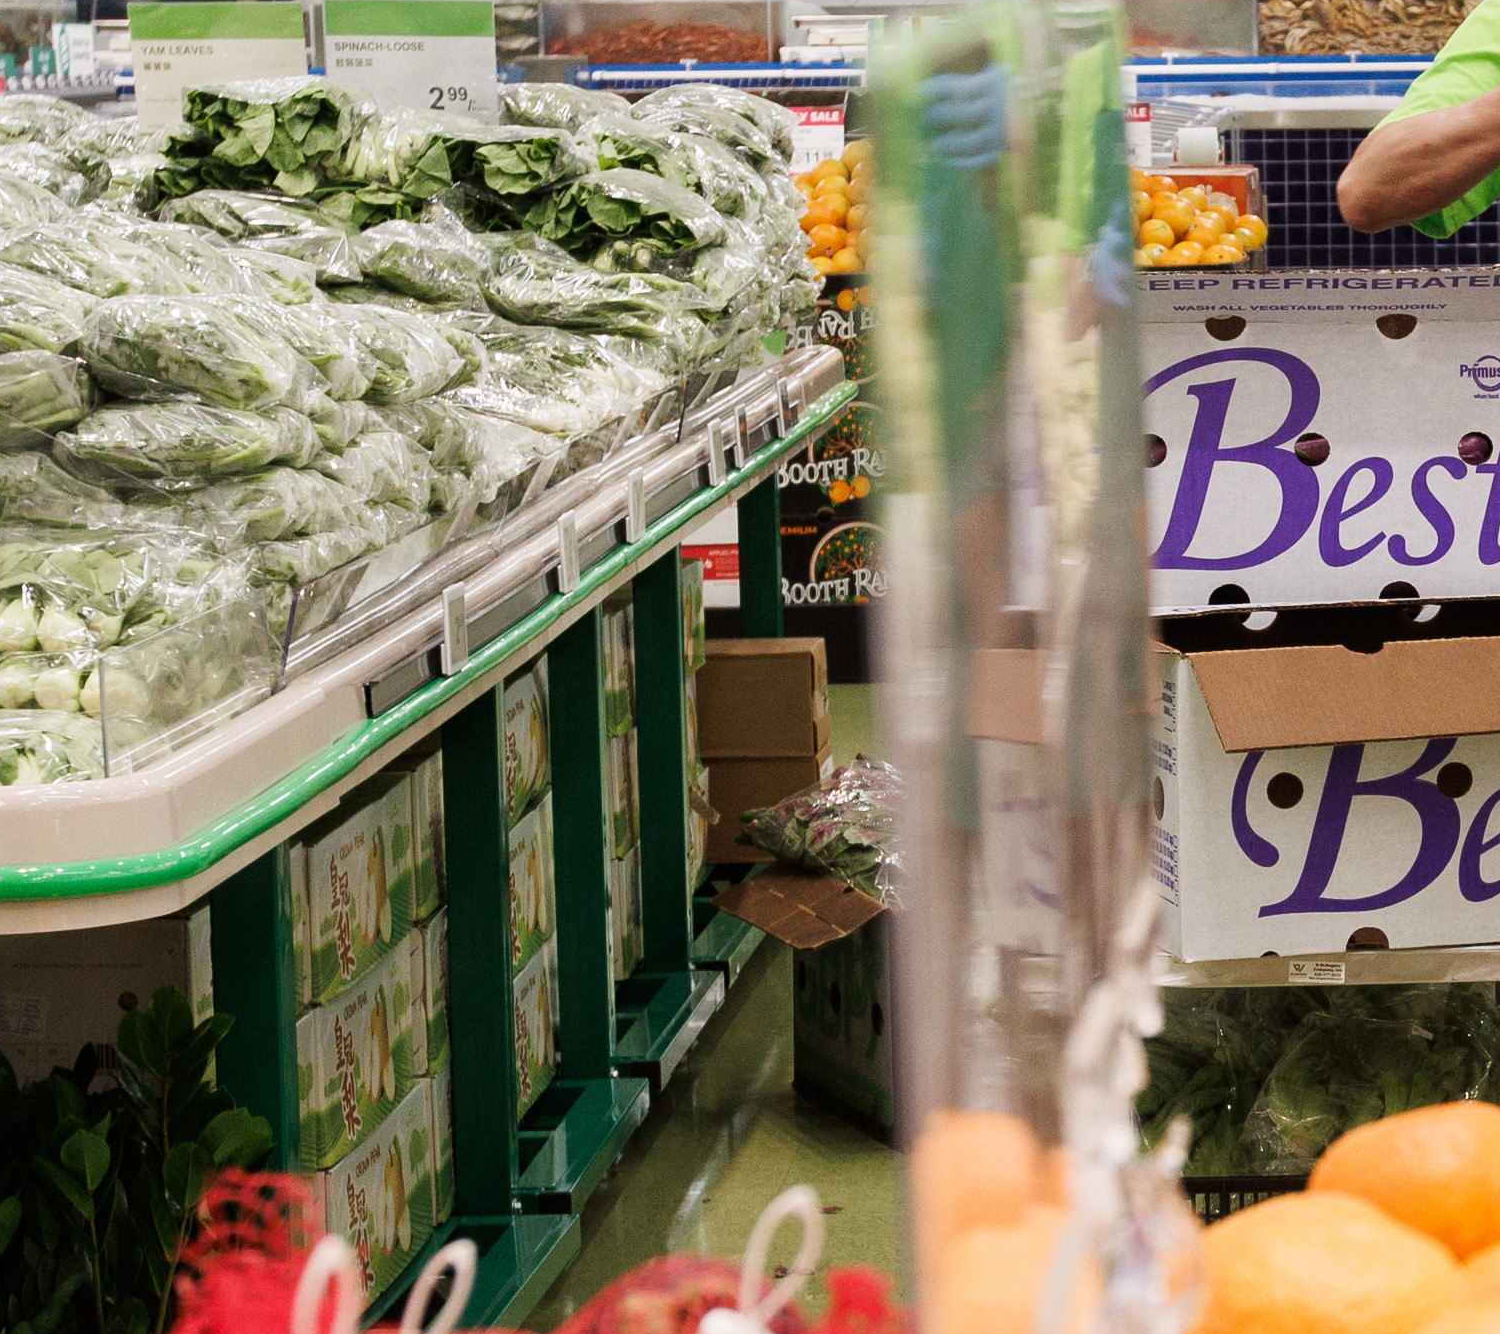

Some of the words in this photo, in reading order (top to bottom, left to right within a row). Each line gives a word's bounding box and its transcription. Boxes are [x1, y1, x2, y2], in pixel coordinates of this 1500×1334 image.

[141, 46, 167, 57] YAM
[169, 45, 215, 56] LEAVES
[333, 41, 425, 52] SPINACH-LOOSE
[810, 111, 840, 123] SALE
[1125, 107, 1148, 119] ALE
[1250, 304, 1345, 312] VEGETABLES
[1348, 303, 1448, 312] THOROUGHLY
